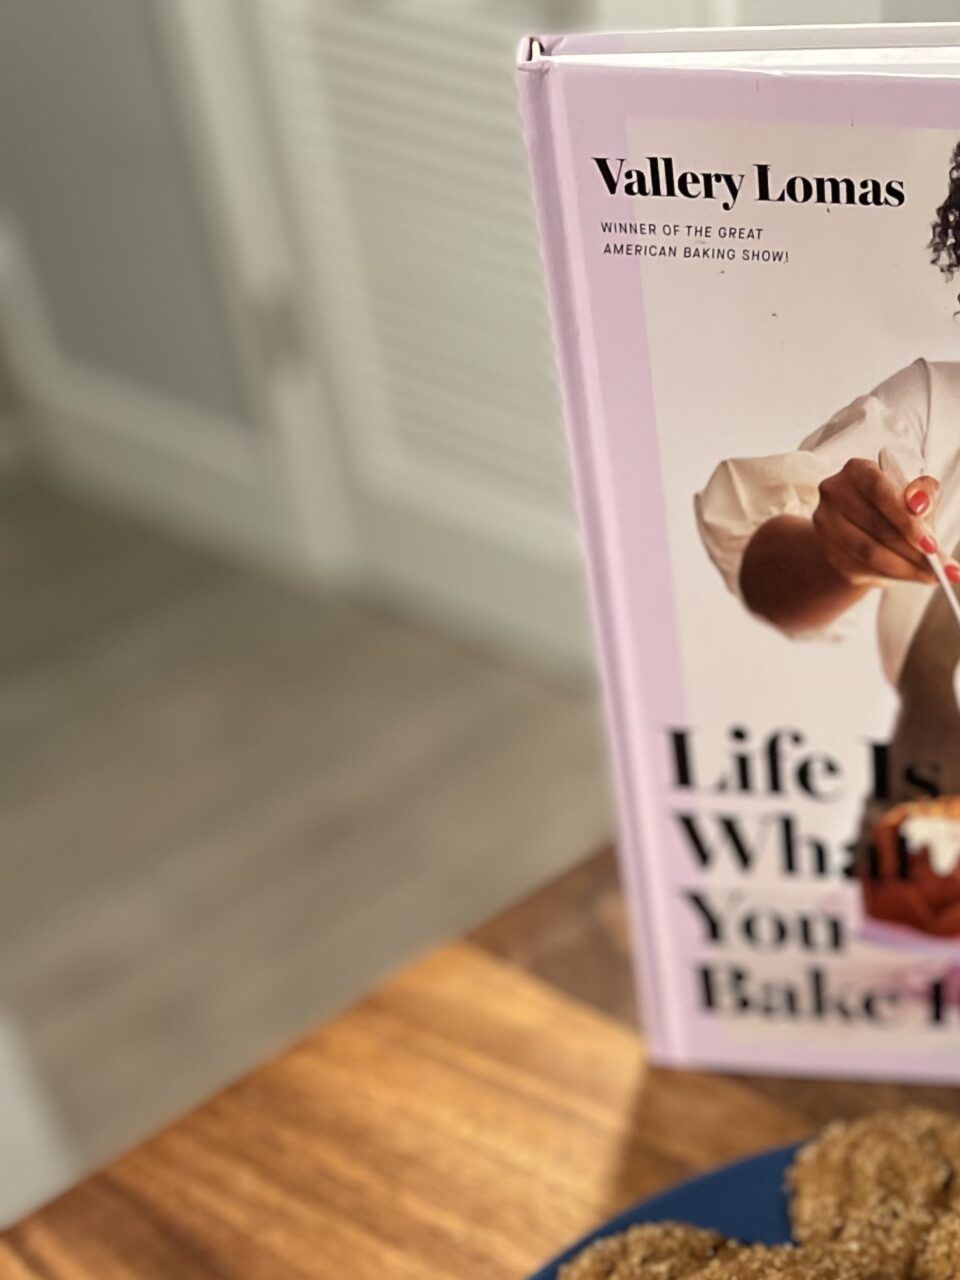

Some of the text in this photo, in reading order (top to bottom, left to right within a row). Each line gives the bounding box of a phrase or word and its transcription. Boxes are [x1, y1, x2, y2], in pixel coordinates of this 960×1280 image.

[592, 157, 906, 211] Vallery Lomas
[601, 221, 764, 240] WINNER OF THE GREAT
[603, 244, 789, 263] AMERICAN BAKING SHOW!
[667, 725, 942, 799] Life Is
[684, 887, 845, 951] You
[695, 963, 900, 1024] Bake
